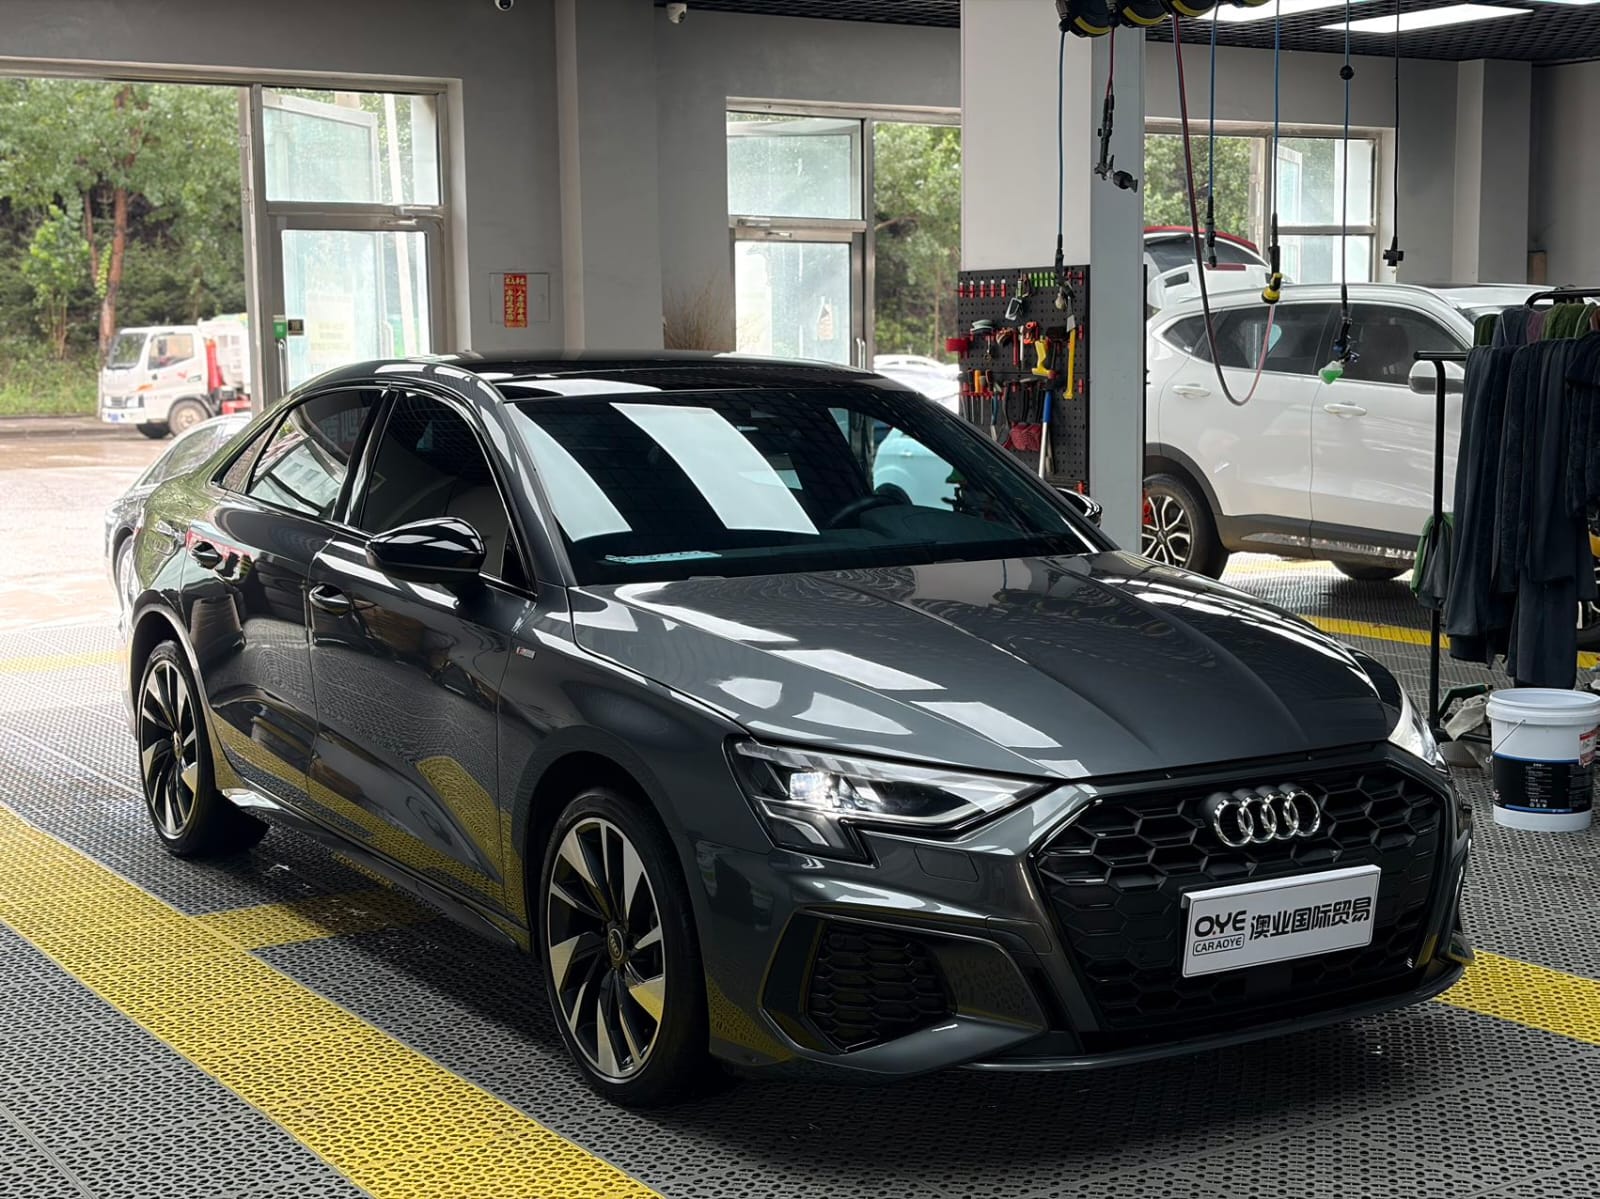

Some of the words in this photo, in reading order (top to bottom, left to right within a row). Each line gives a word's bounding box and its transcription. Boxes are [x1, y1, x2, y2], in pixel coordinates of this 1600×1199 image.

[1249, 896, 1372, 941] 澳业国际贸易
